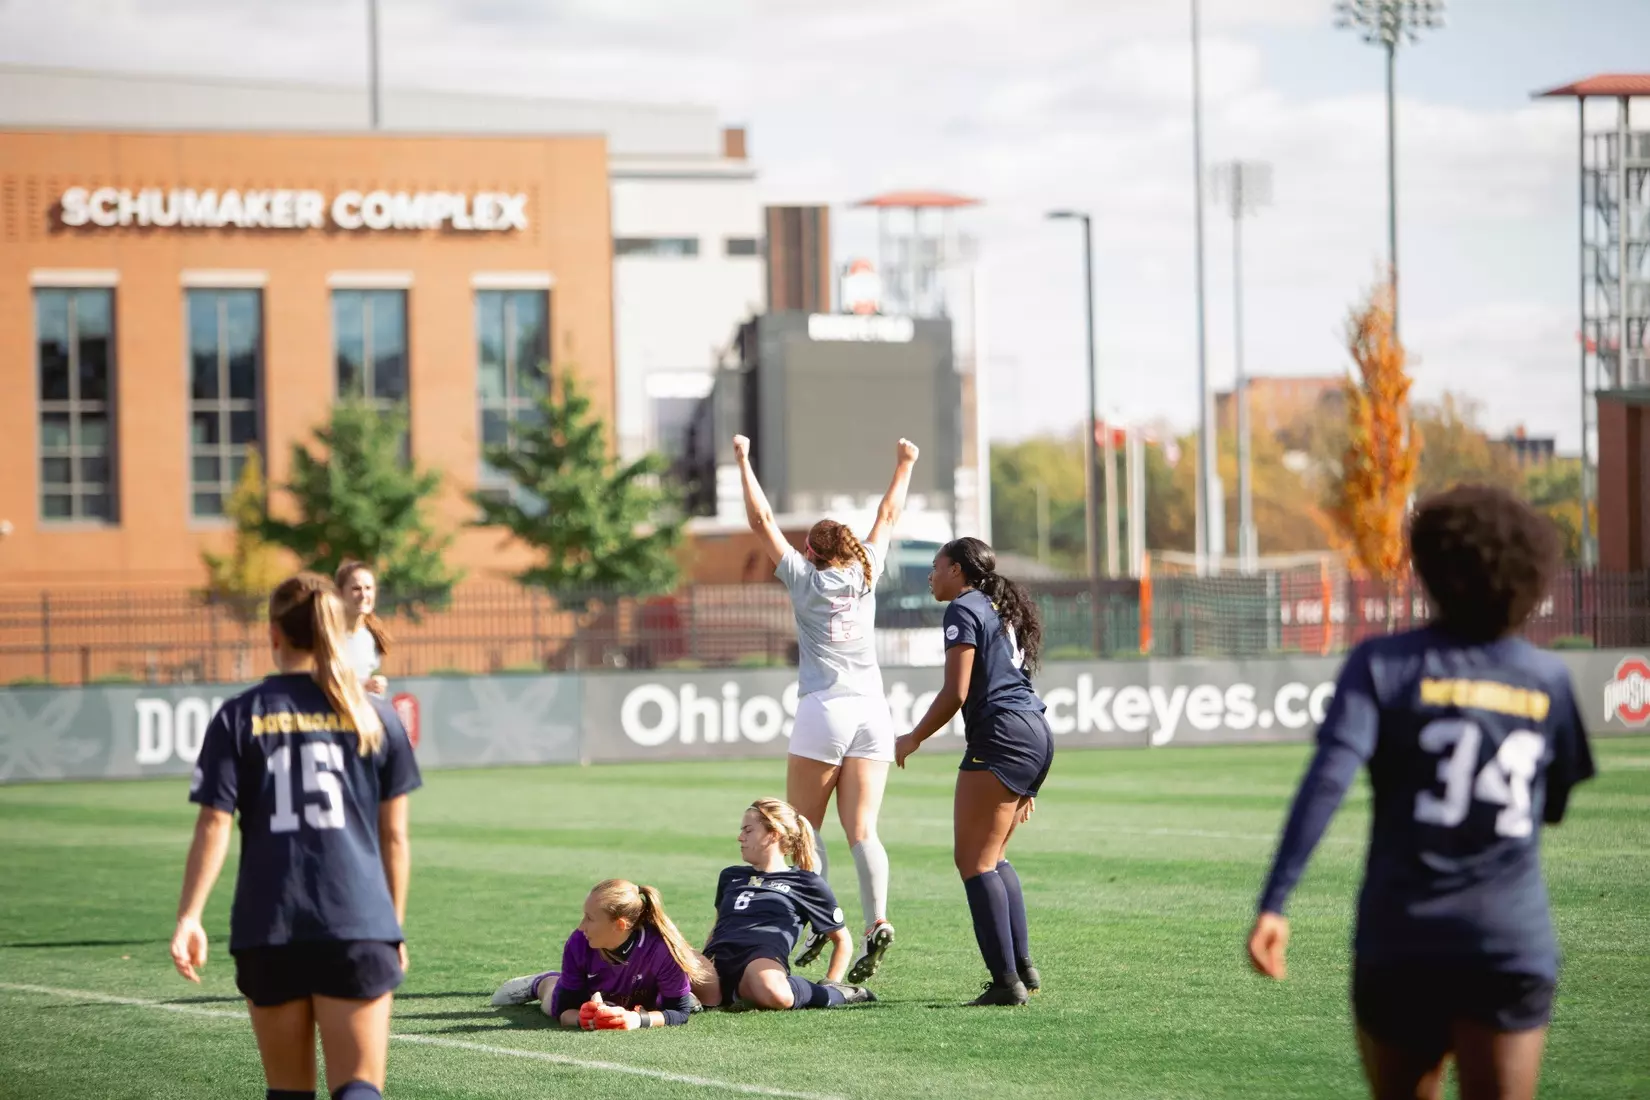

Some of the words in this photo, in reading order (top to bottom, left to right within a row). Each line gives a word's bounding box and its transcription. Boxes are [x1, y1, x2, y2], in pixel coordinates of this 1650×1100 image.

[61, 186, 325, 229] SCHUMAKER
[331, 191, 528, 232] COMPLEX
[267, 741, 346, 833] 15
[1413, 718, 1547, 838] 34
[734, 890, 755, 910] 6
